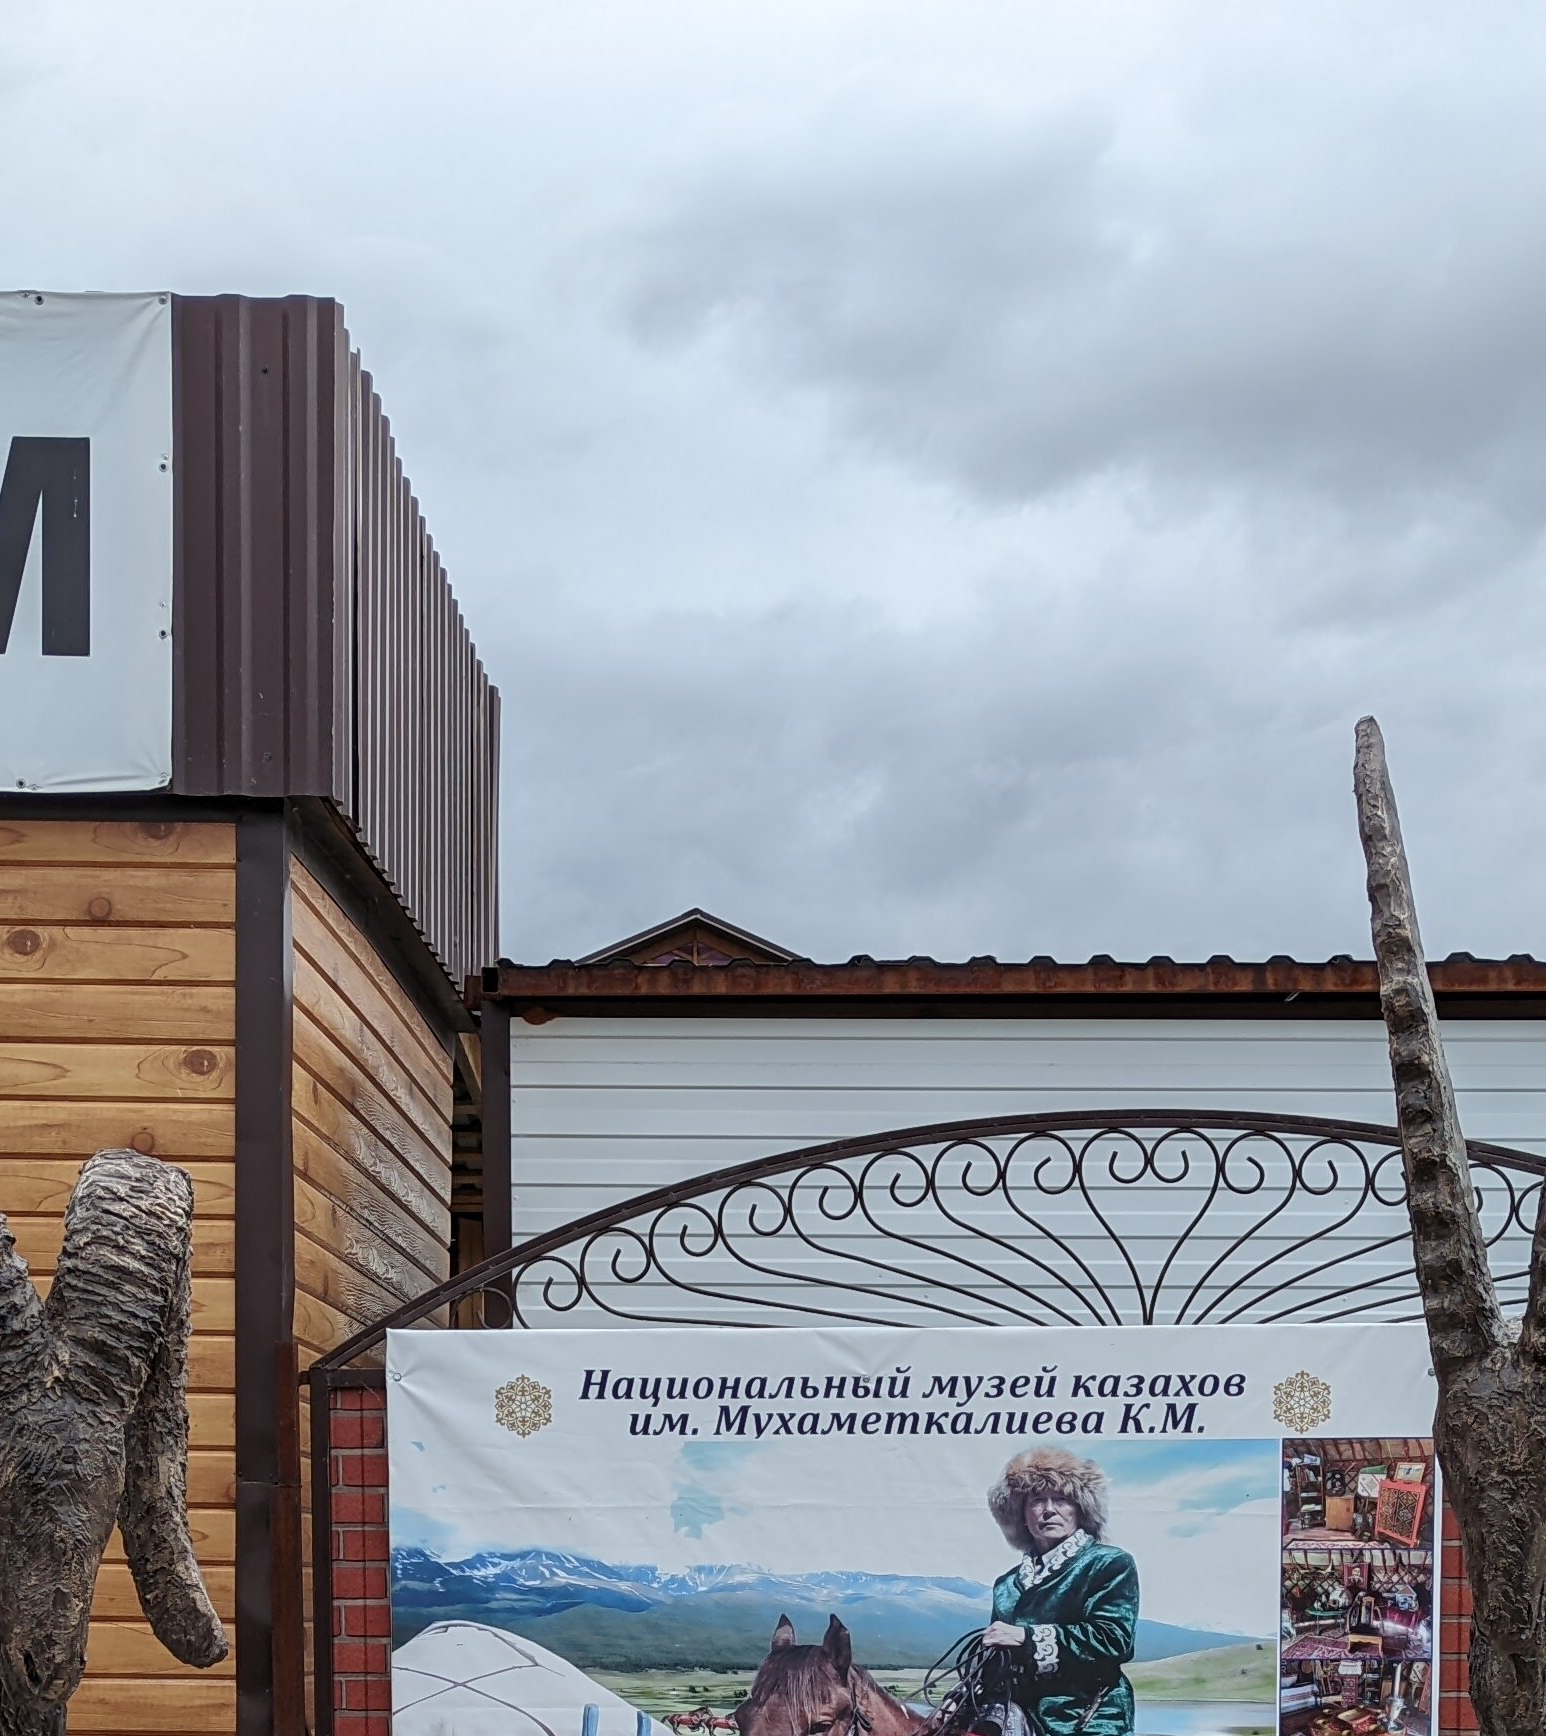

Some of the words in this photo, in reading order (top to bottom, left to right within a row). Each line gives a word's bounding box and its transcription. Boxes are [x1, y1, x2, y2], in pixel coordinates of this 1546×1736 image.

[579, 1365, 912, 1408] Национальный
[921, 1365, 1058, 1408] музей
[1071, 1373, 1246, 1398] казахов
[629, 1411, 699, 1436] им.
[713, 1405, 1105, 1440] Мухаметкалиева
[1117, 1402, 1205, 1434] К.М.
